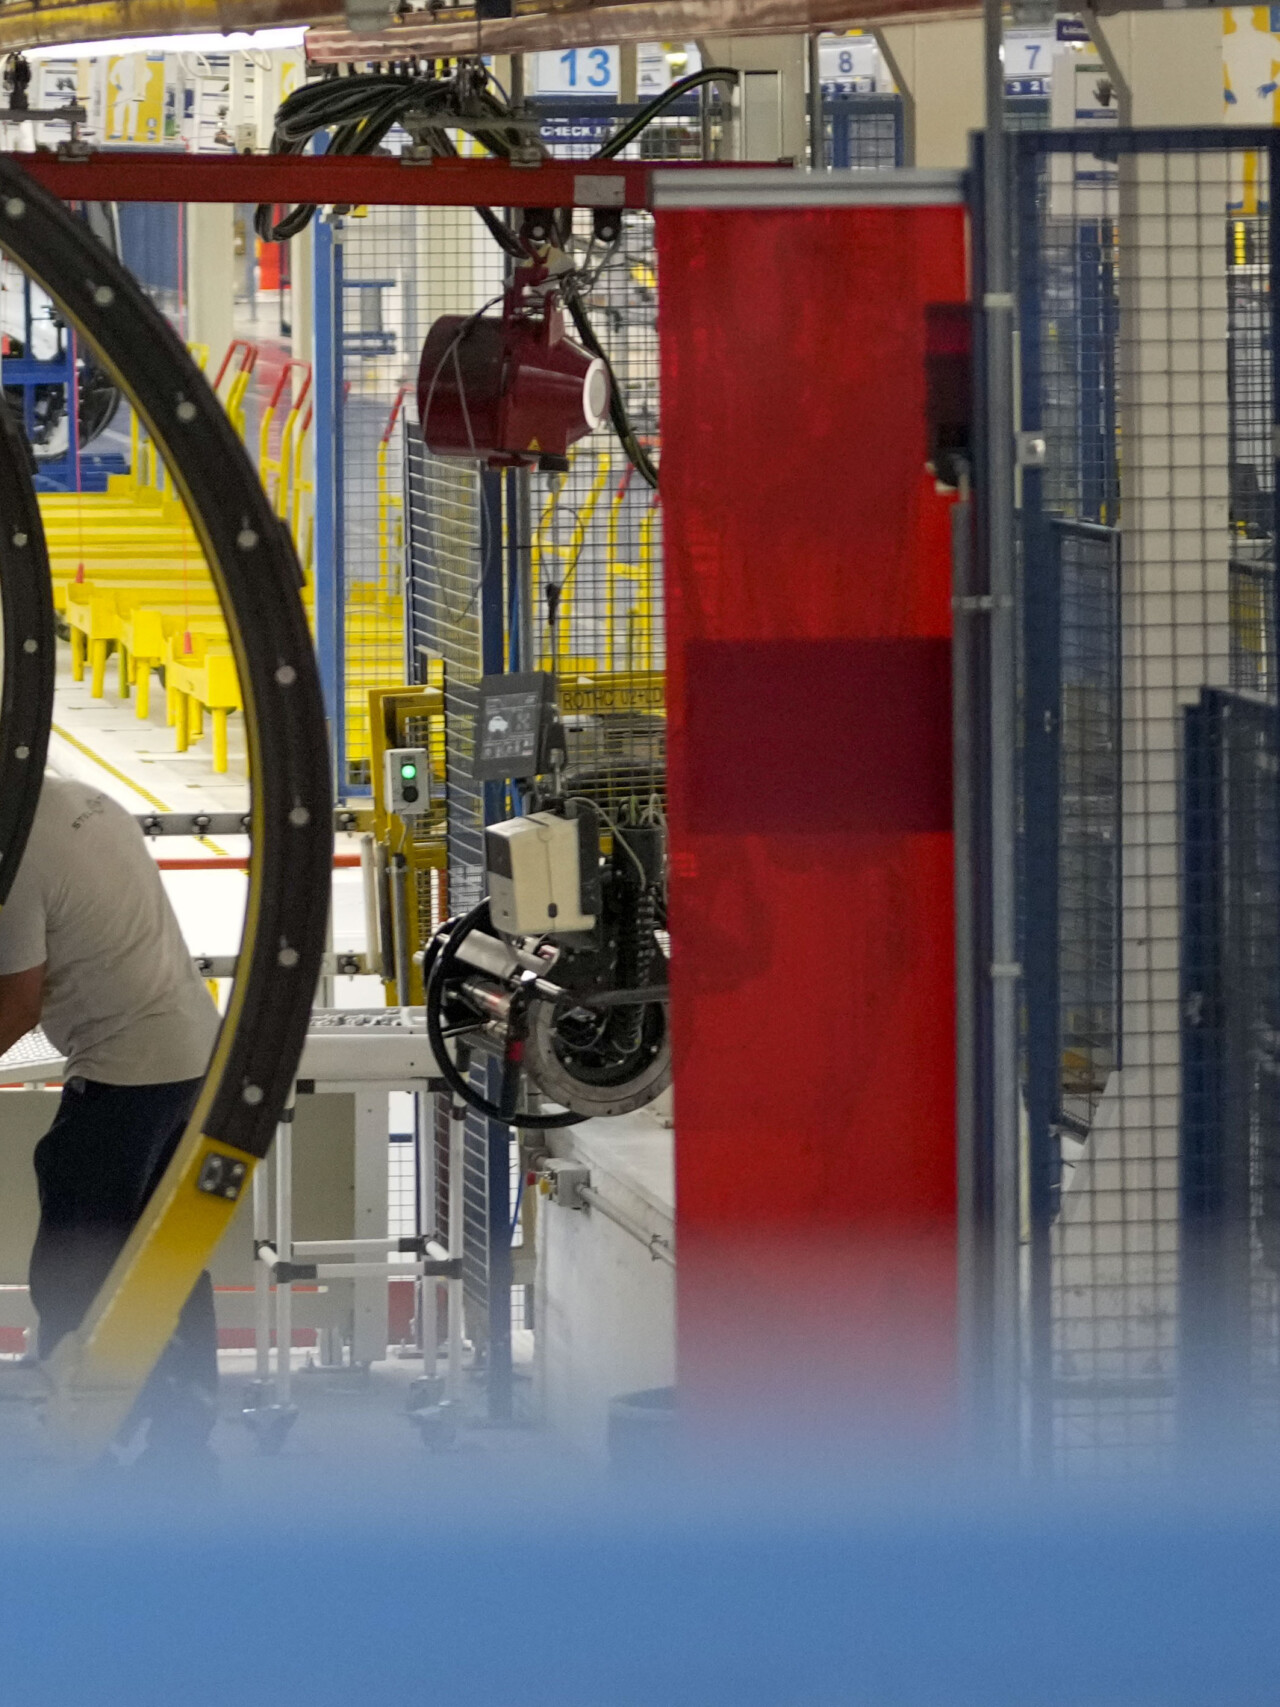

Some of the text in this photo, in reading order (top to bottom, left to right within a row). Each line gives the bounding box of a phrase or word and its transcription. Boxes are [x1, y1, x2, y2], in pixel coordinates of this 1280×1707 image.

[560, 48, 611, 87] 13
[838, 50, 853, 74] 8
[1024, 44, 1042, 71] 7
